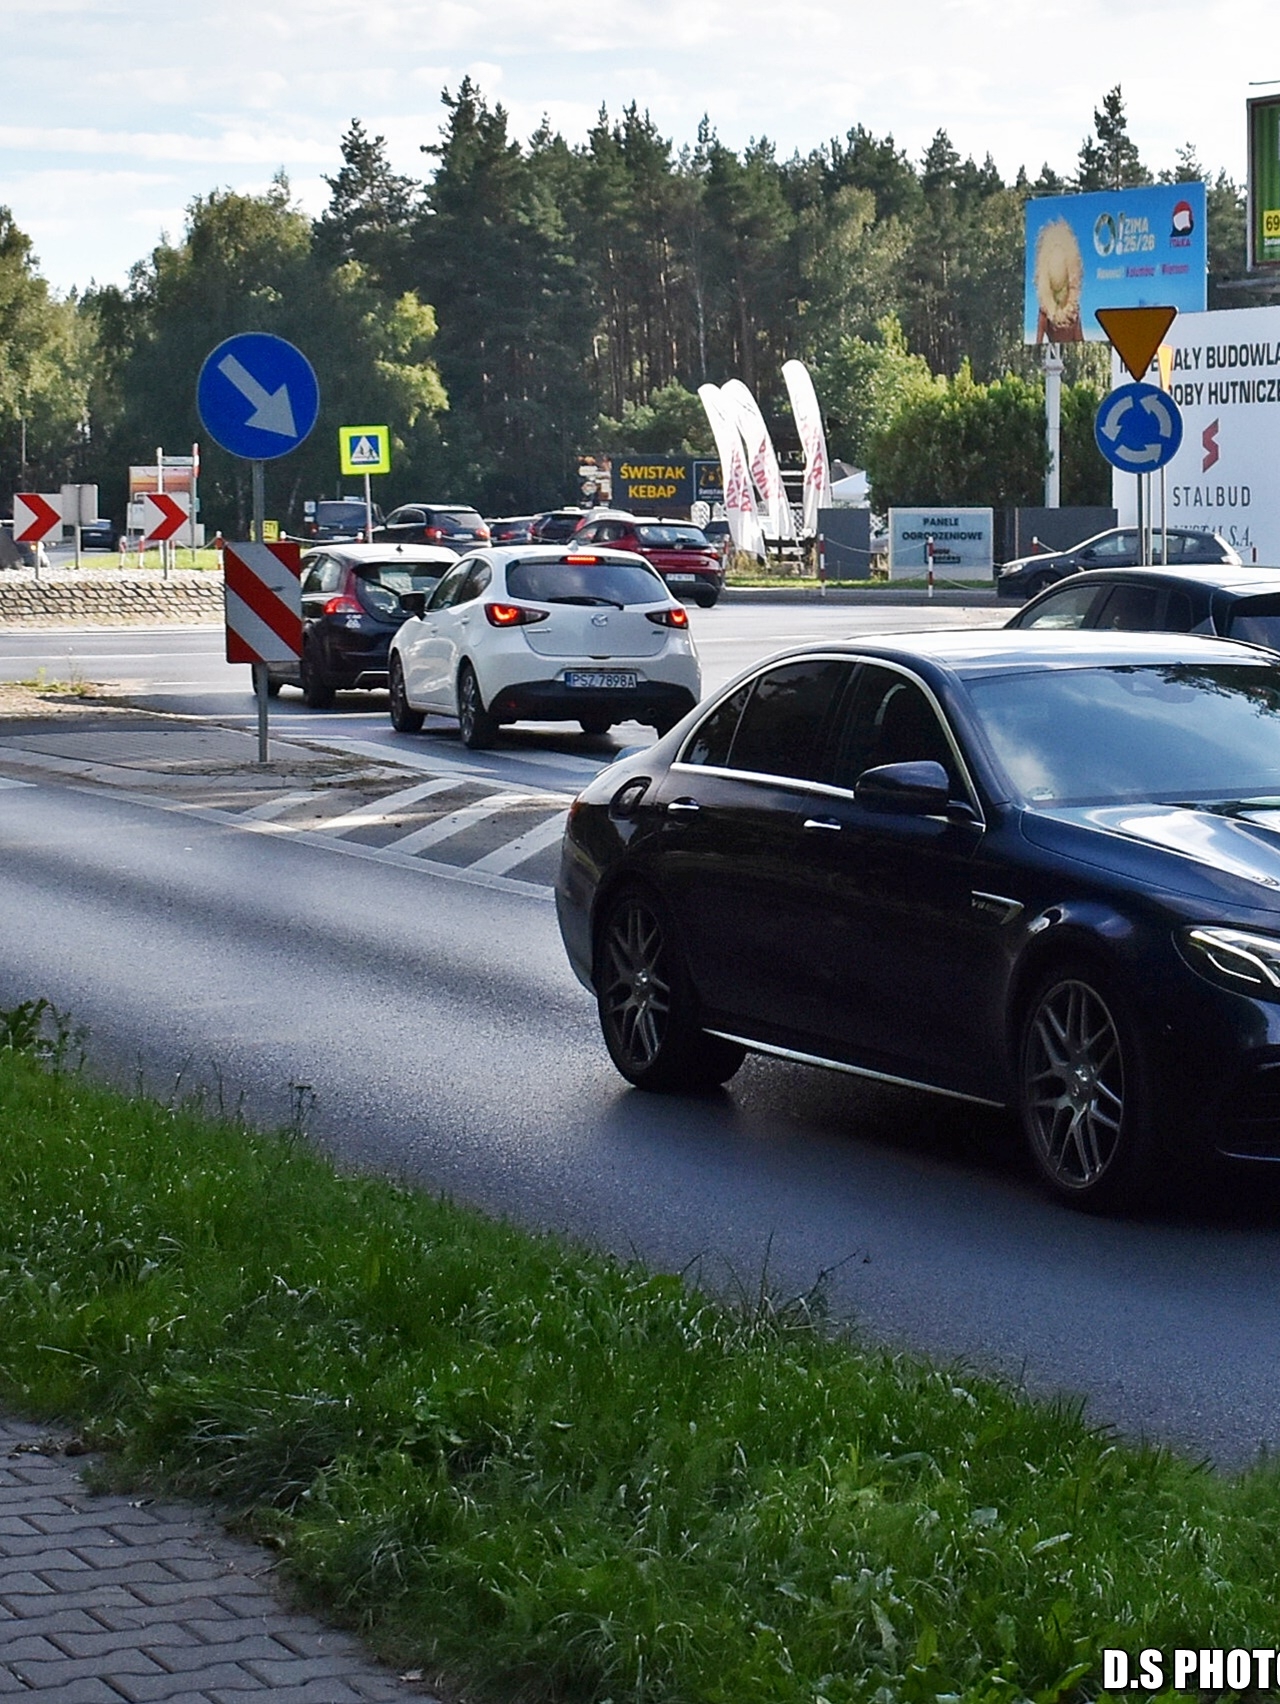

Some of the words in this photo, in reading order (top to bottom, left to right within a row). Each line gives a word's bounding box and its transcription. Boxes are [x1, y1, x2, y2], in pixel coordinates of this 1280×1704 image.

[1124, 217, 1149, 234] ZIMA
[619, 463, 685, 479] ŚWISTAK
[628, 485, 676, 498] KEBAP
[1173, 486, 1251, 507] STALBUD
[923, 517, 959, 526] PANELE
[902, 531, 983, 540] OGRODZENIOWE
[572, 674, 596, 687] PSZ
